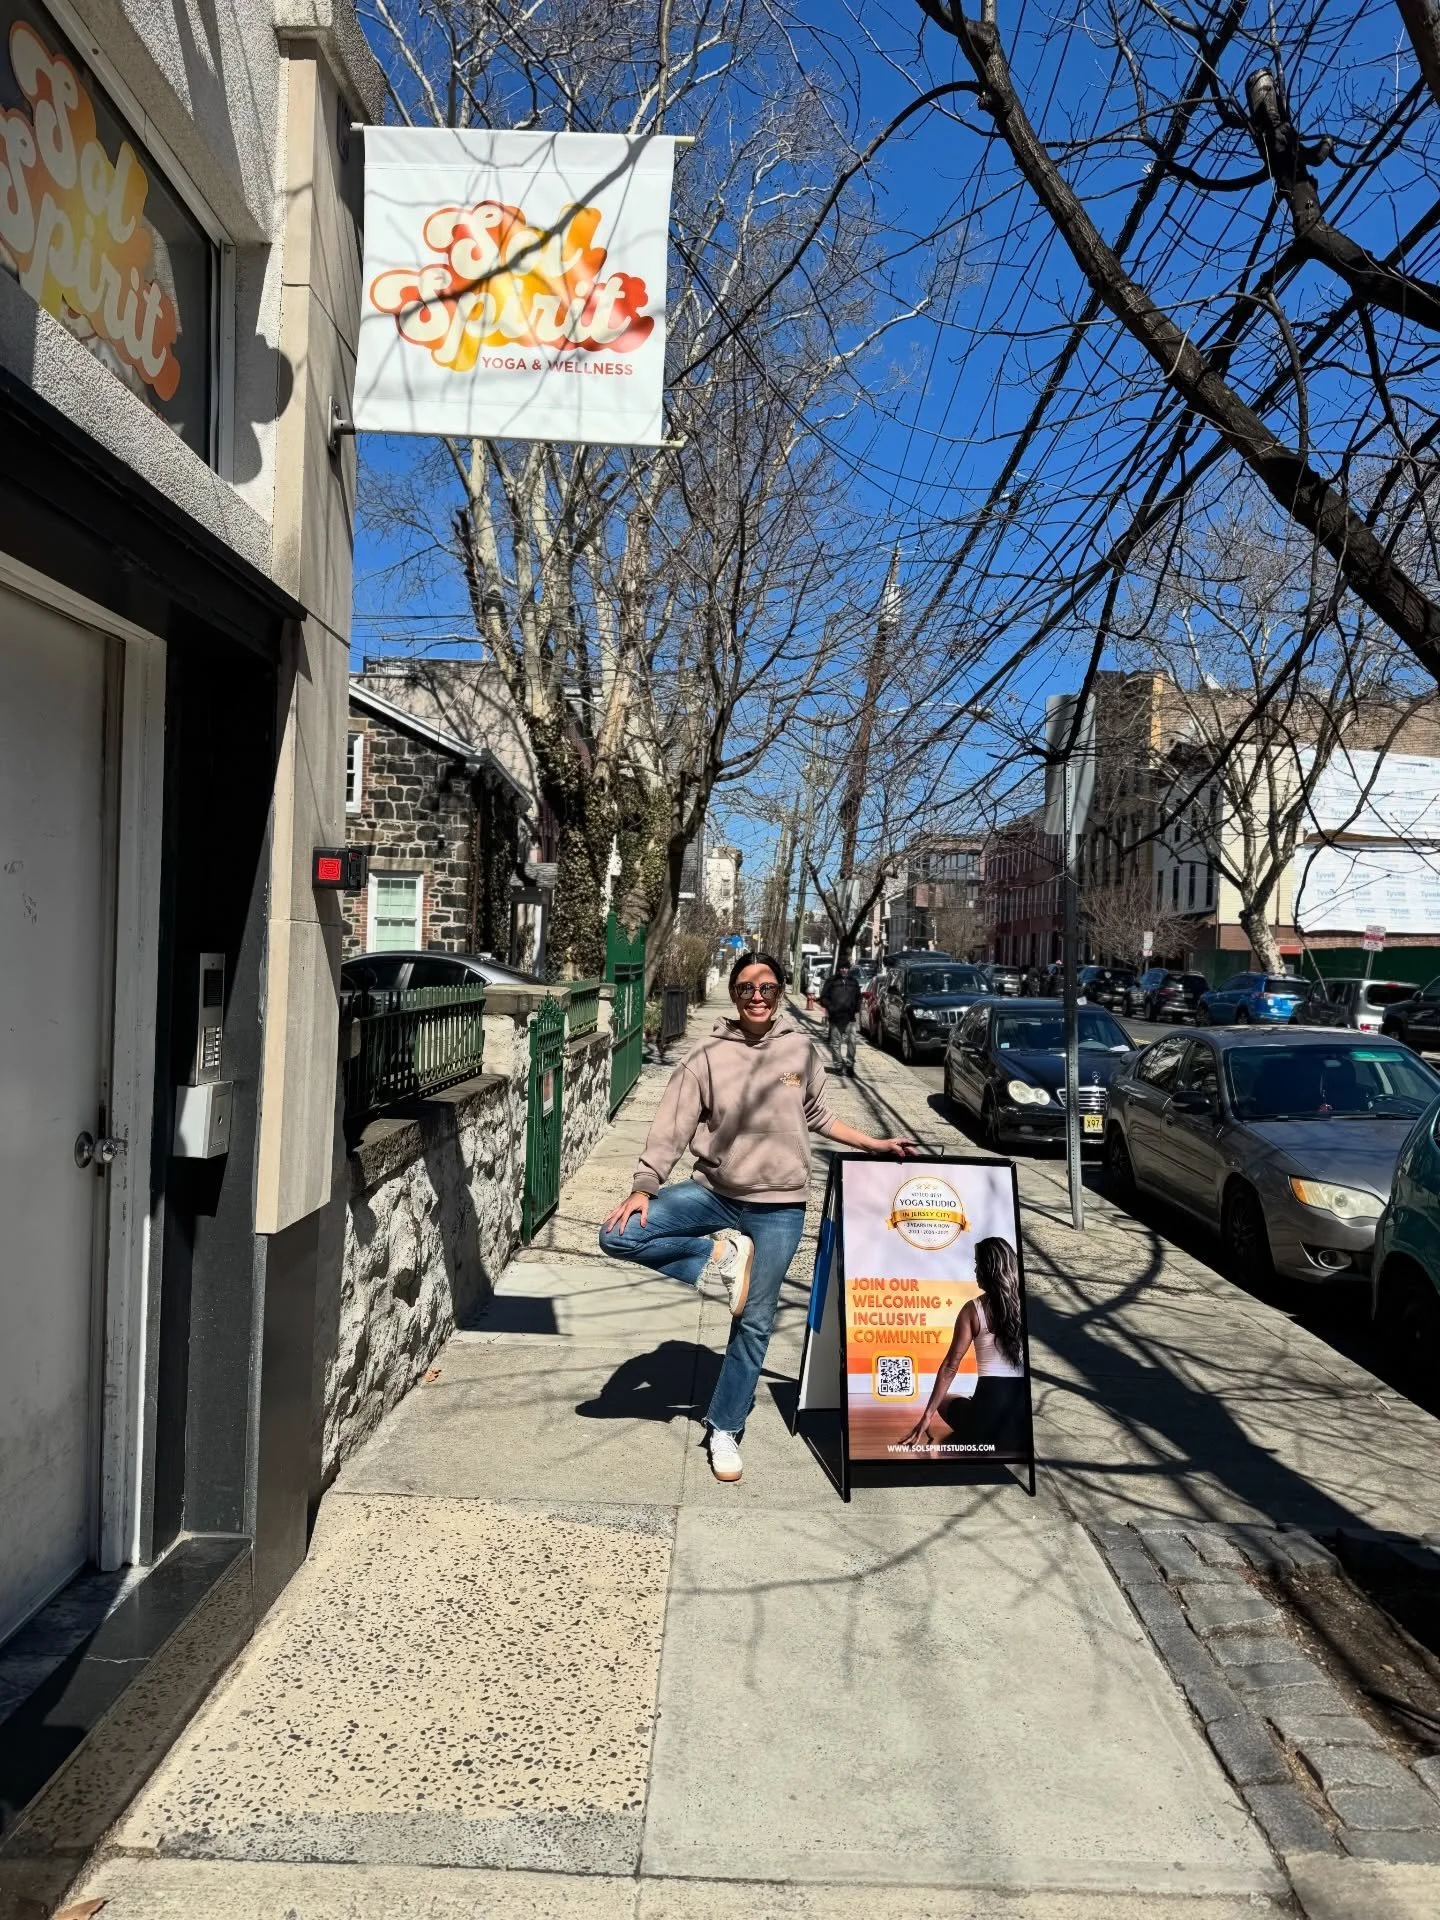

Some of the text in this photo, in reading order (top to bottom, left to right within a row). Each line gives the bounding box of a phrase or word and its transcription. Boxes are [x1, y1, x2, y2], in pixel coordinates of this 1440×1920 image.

[10, 21, 137, 245] Sol
[425, 202, 584, 280] Sol
[372, 264, 634, 364] Spirit
[482, 356, 634, 376] YOGA & WELLNESS
[1386, 890, 1406, 898] Tyvek
[925, 1200, 957, 1208] STUDIO
[852, 1277, 919, 1292] JOIN OUR
[852, 1295, 942, 1309] WELCOMING
[853, 1312, 927, 1326] INCLUSIVE
[853, 1329, 942, 1344] COMMUNITY
[887, 1444, 996, 1452] WWW.SOLSPIRITSTUDIOS.COM
